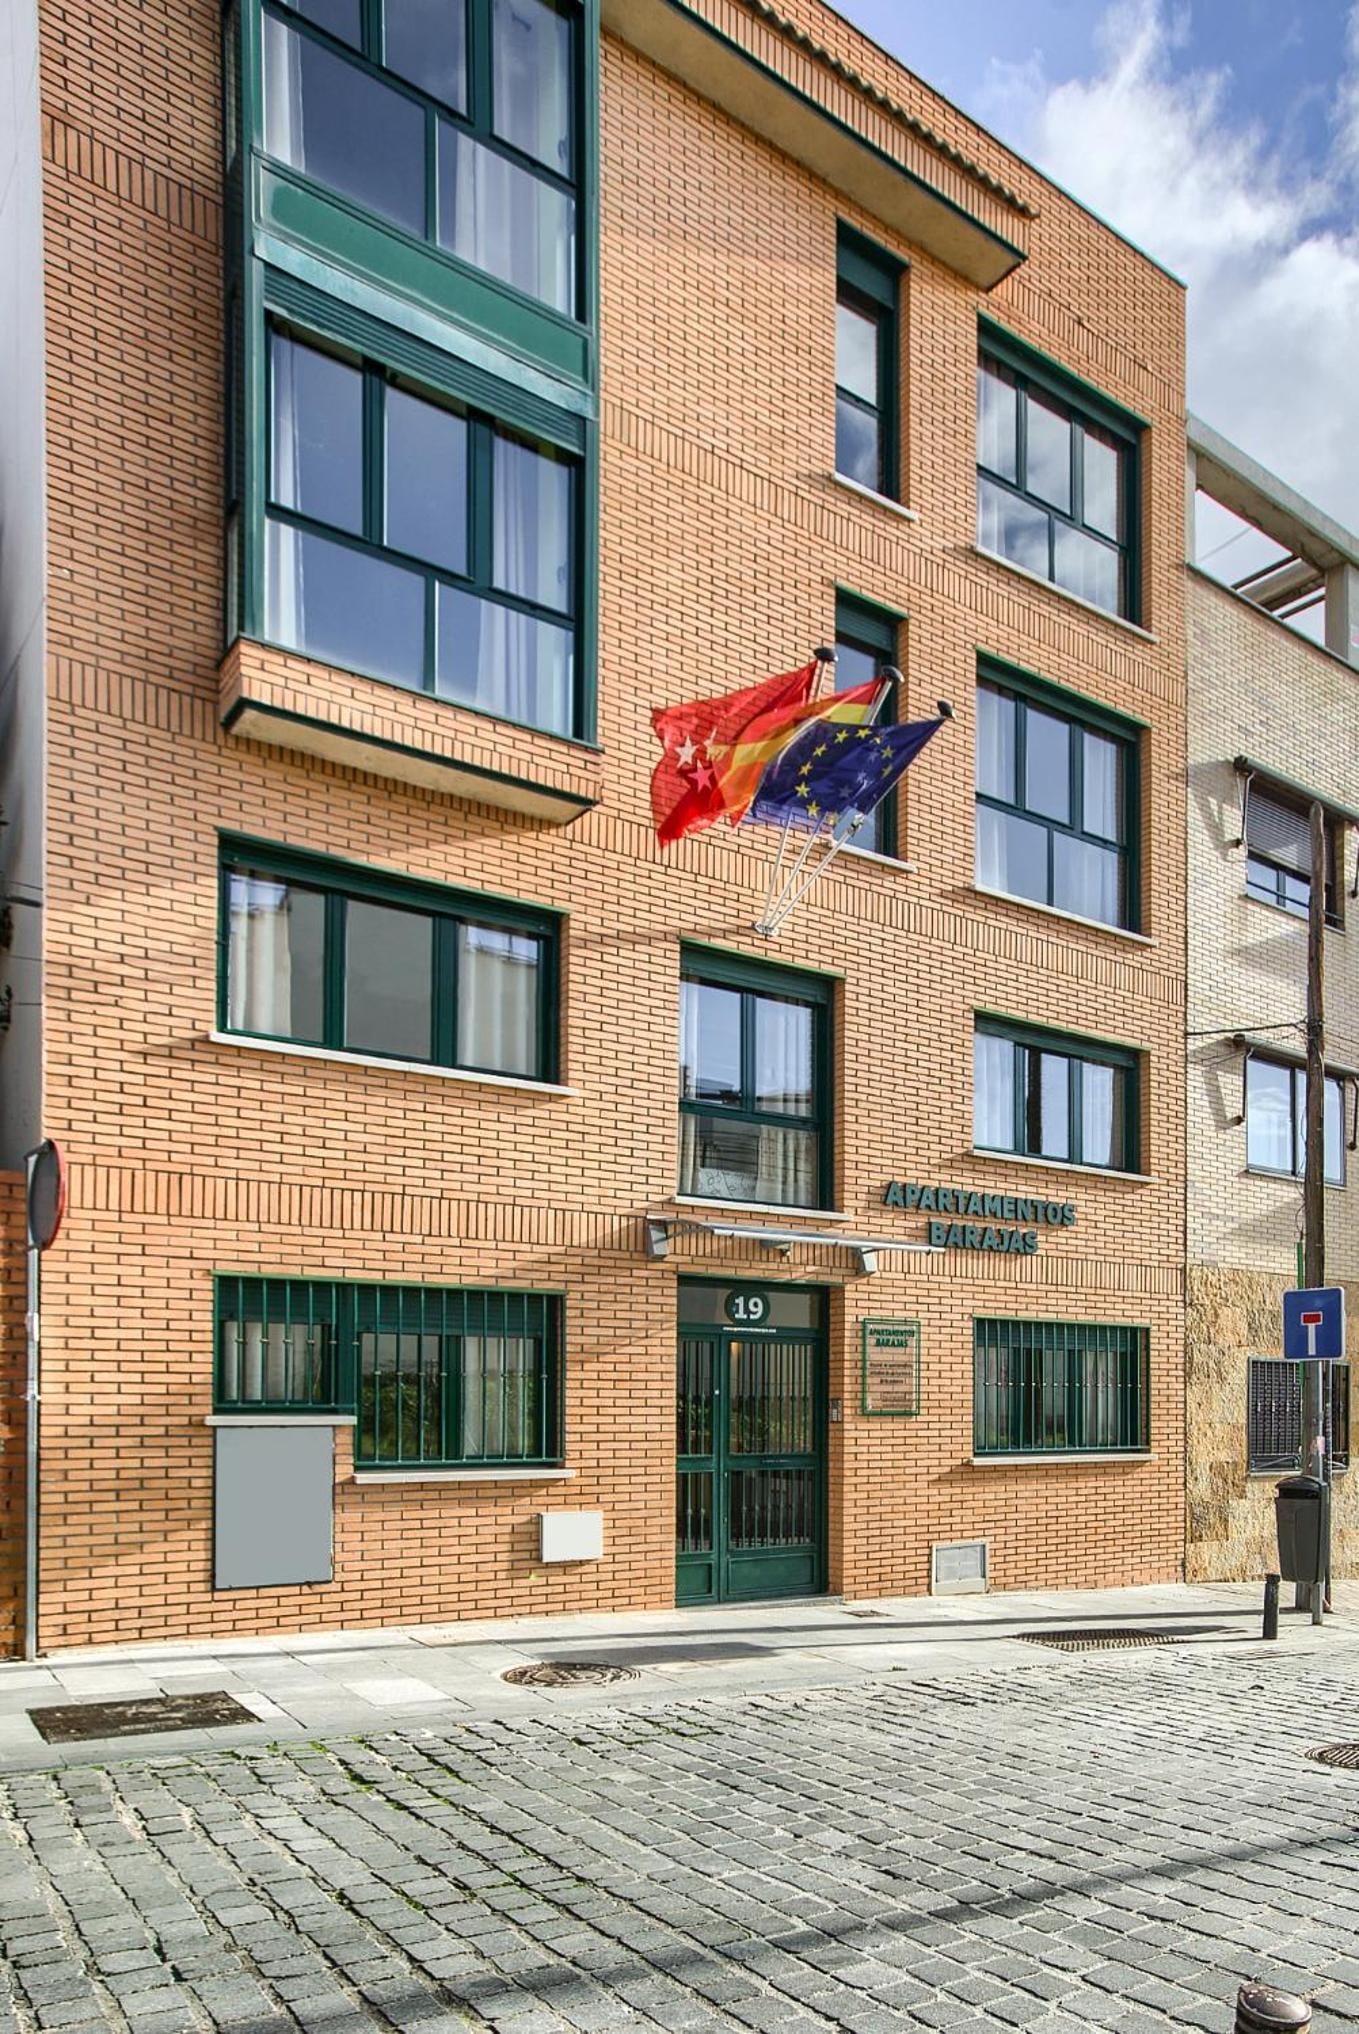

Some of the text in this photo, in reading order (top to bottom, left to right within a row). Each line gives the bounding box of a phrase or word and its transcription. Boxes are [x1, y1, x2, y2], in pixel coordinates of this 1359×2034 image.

[884, 1181, 1076, 1226] APARTAMENTOS
[929, 1221, 1038, 1254] BARAJAS
[734, 1296, 763, 1320] 19
